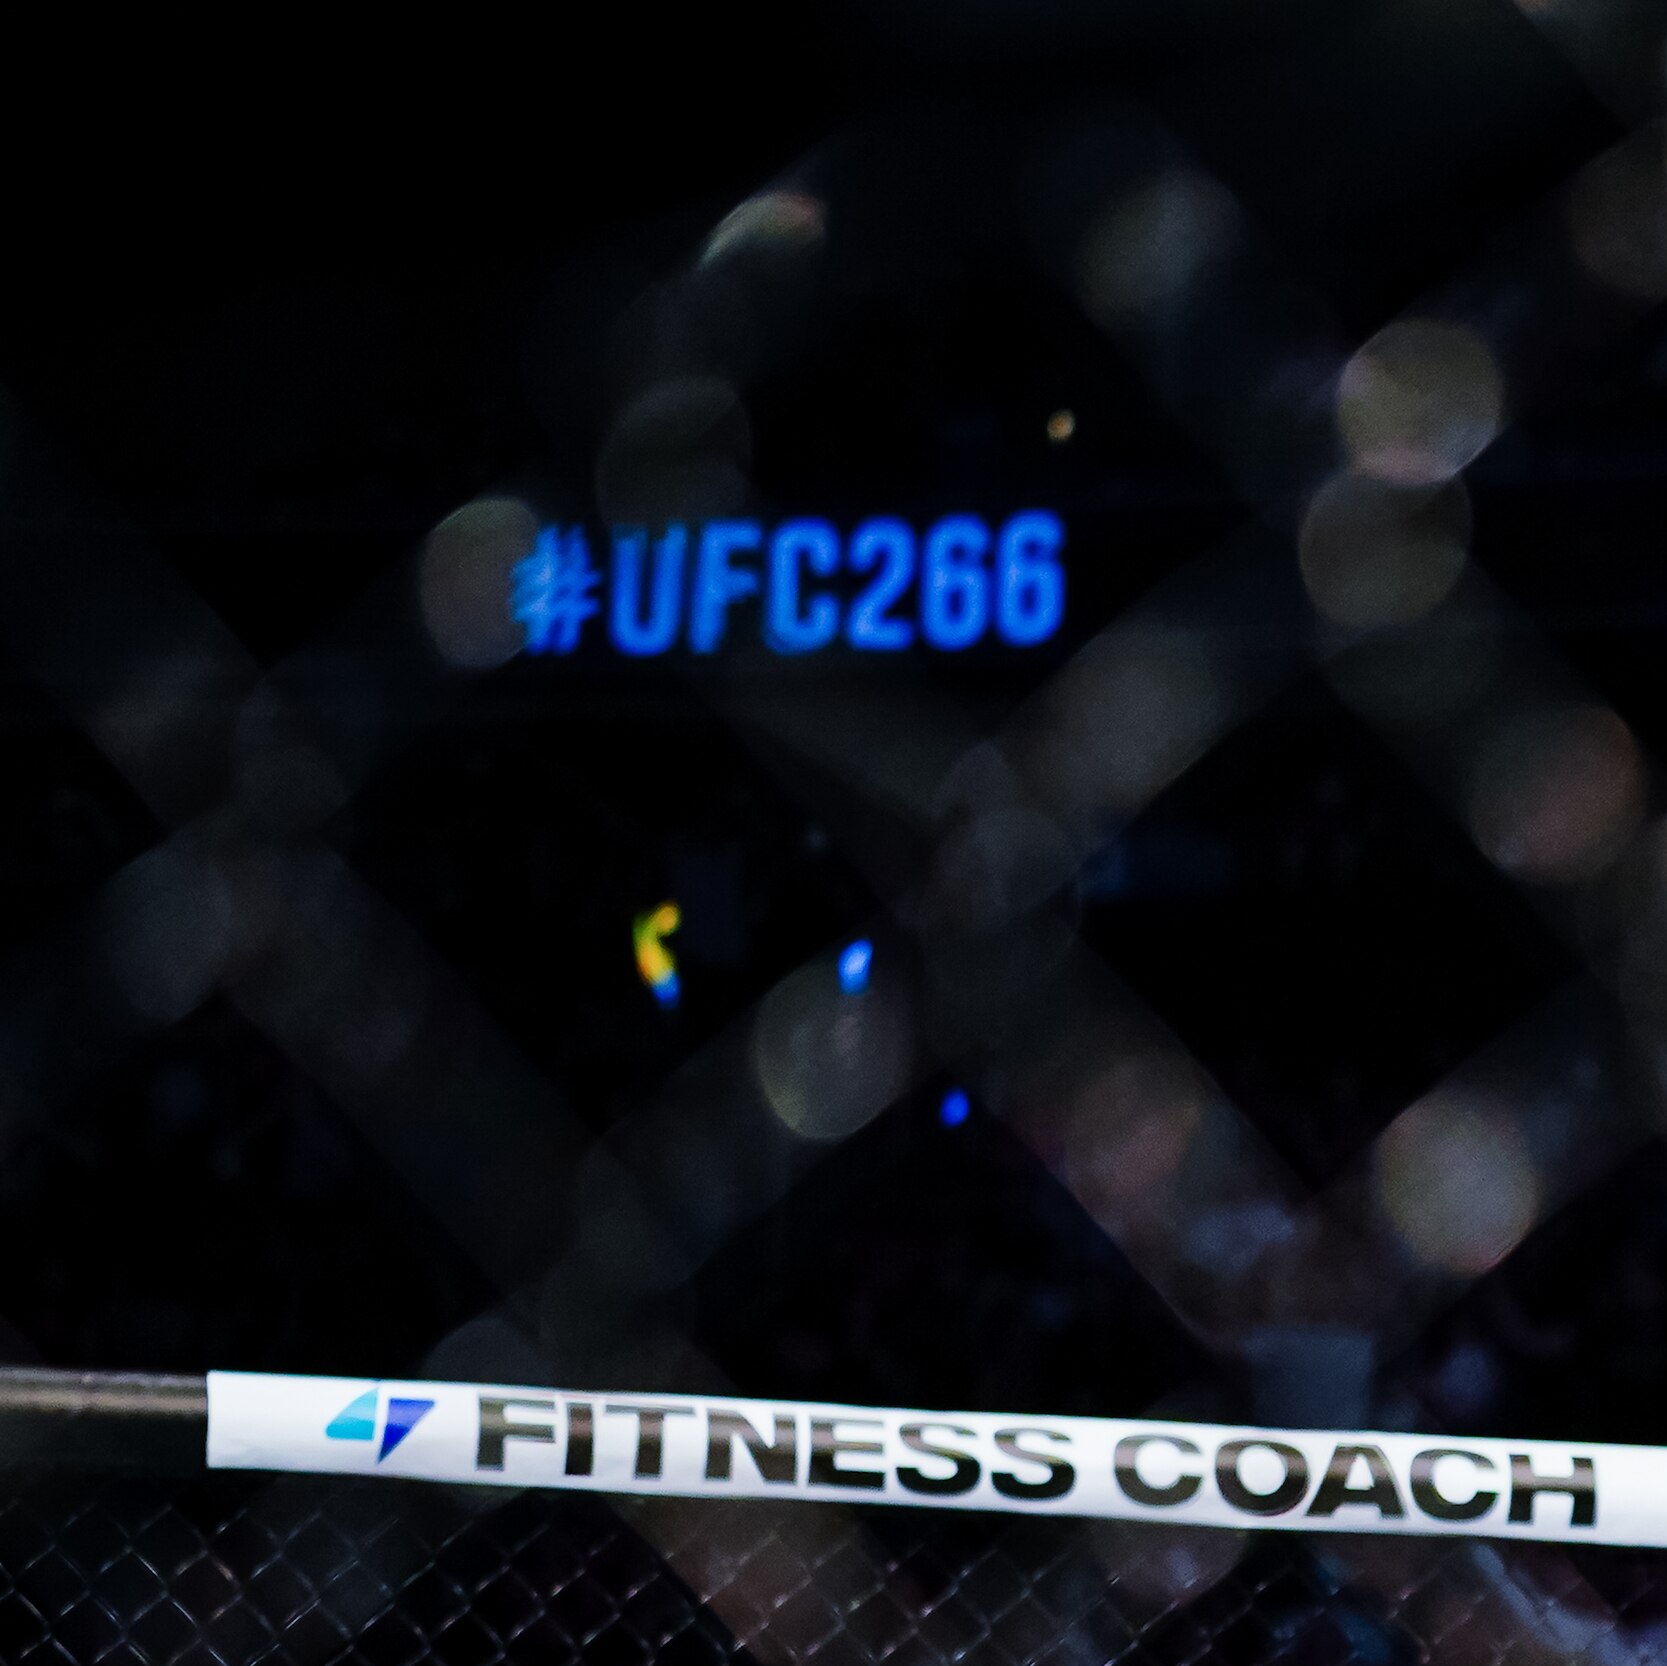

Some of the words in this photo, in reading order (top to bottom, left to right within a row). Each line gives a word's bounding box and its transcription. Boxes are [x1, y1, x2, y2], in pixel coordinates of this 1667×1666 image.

[510, 509, 1067, 655] #UFC266
[474, 1393, 1077, 1497] FITNESS
[1113, 1433, 1598, 1528] COACH
